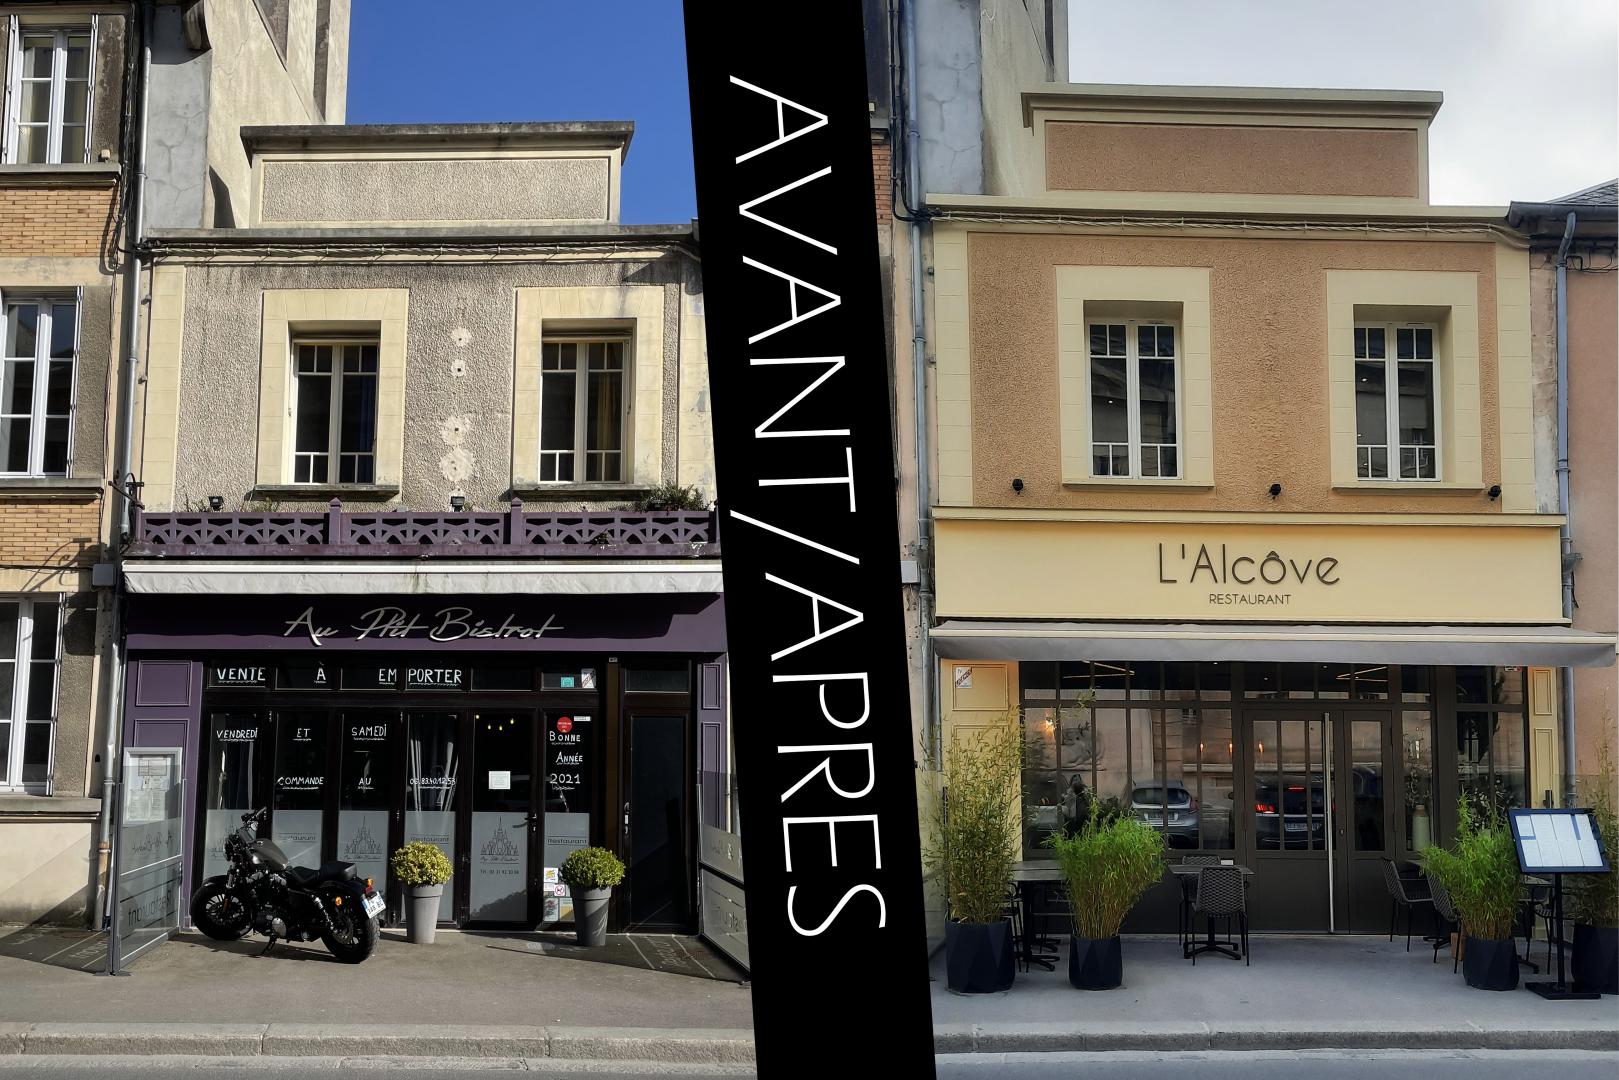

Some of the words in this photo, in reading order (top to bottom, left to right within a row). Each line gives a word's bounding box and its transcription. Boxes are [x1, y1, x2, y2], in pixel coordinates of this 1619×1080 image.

[1159, 542, 1340, 586] L'Alcôve
[1209, 593, 1292, 605] RESTAURANT
[283, 606, 339, 646] Au
[429, 606, 565, 641] Bistrot
[216, 667, 266, 681] VENTE
[378, 668, 398, 682] EM
[408, 668, 463, 684] PORTER
[296, 728, 311, 739] ET
[276, 776, 324, 786] COMMANDE
[358, 777, 372, 786] AU
[549, 773, 581, 785] 2021
